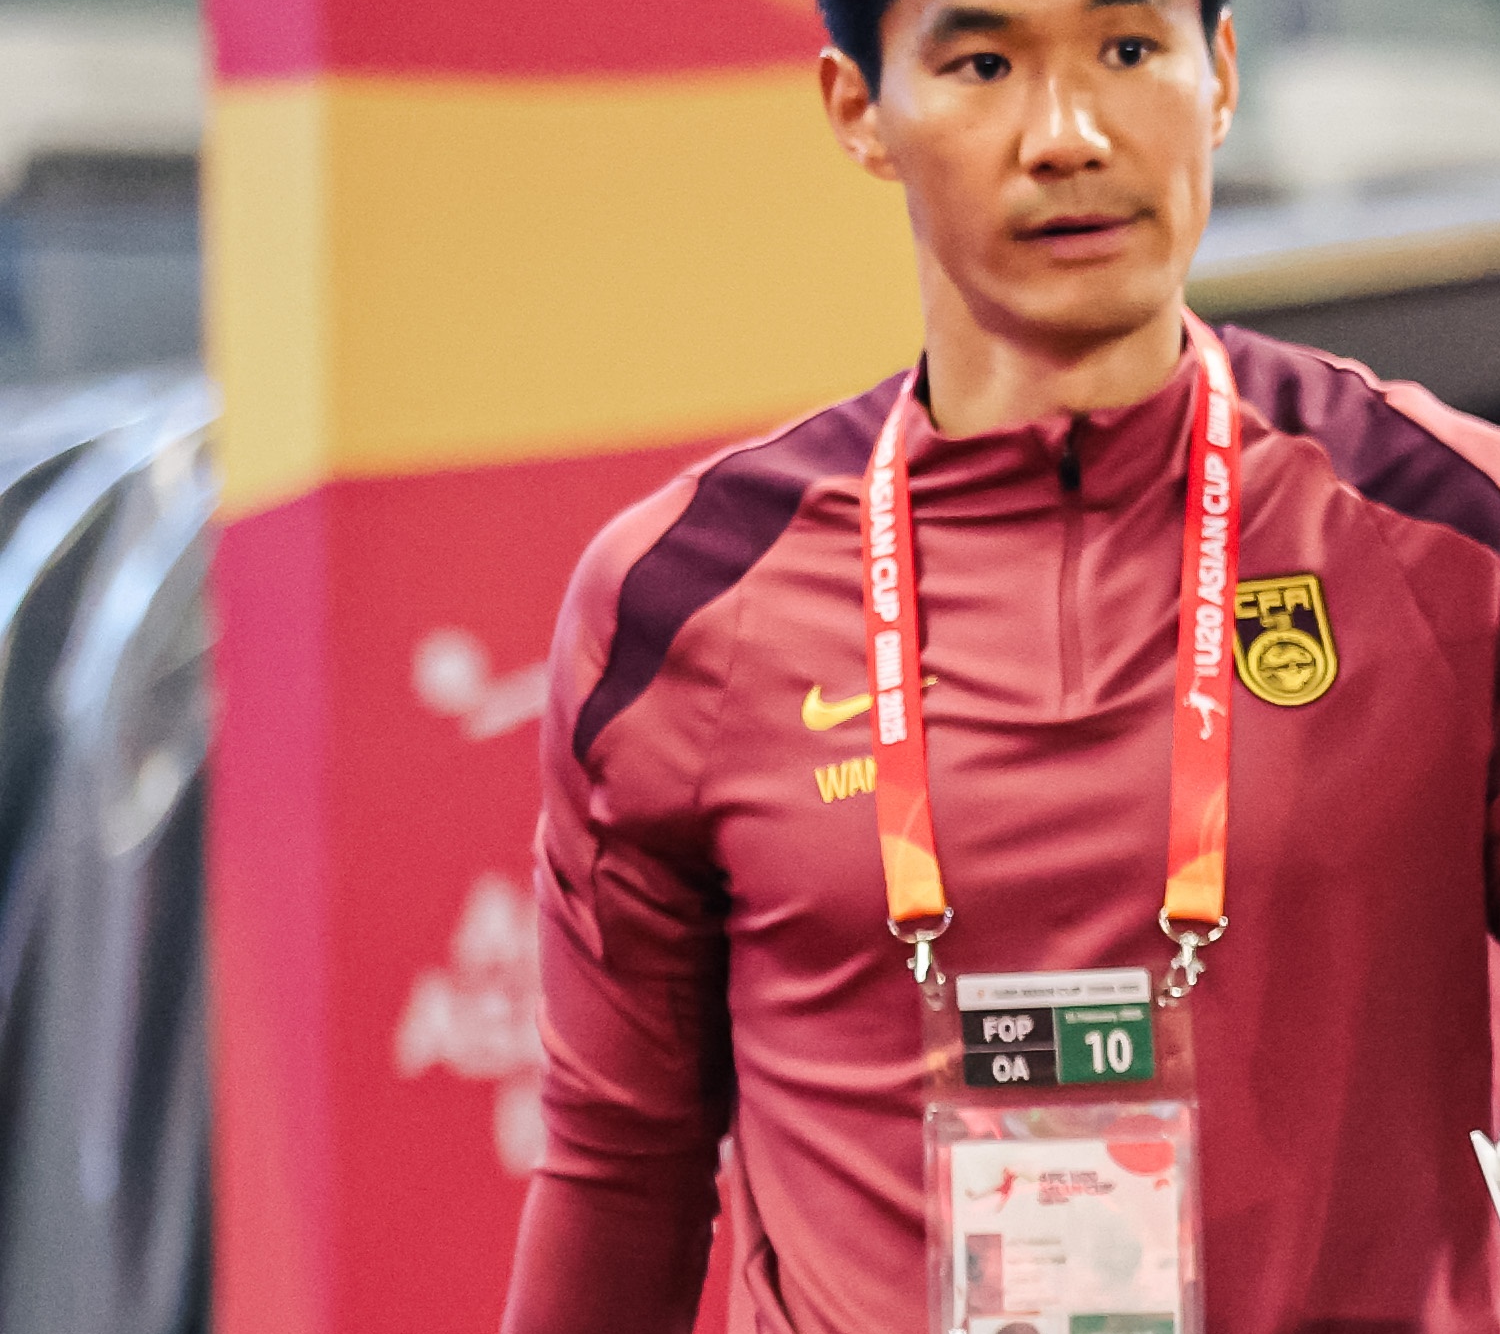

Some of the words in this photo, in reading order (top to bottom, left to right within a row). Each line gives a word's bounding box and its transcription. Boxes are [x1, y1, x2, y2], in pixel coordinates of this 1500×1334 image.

[870, 468, 897, 558] ASIAN
[1203, 451, 1231, 516] CUP
[872, 558, 901, 622] CUP
[1197, 515, 1229, 606] ASIAN
[1194, 604, 1223, 663] U20
[983, 1014, 1034, 1043] FOP
[1085, 1028, 1133, 1074] 10
